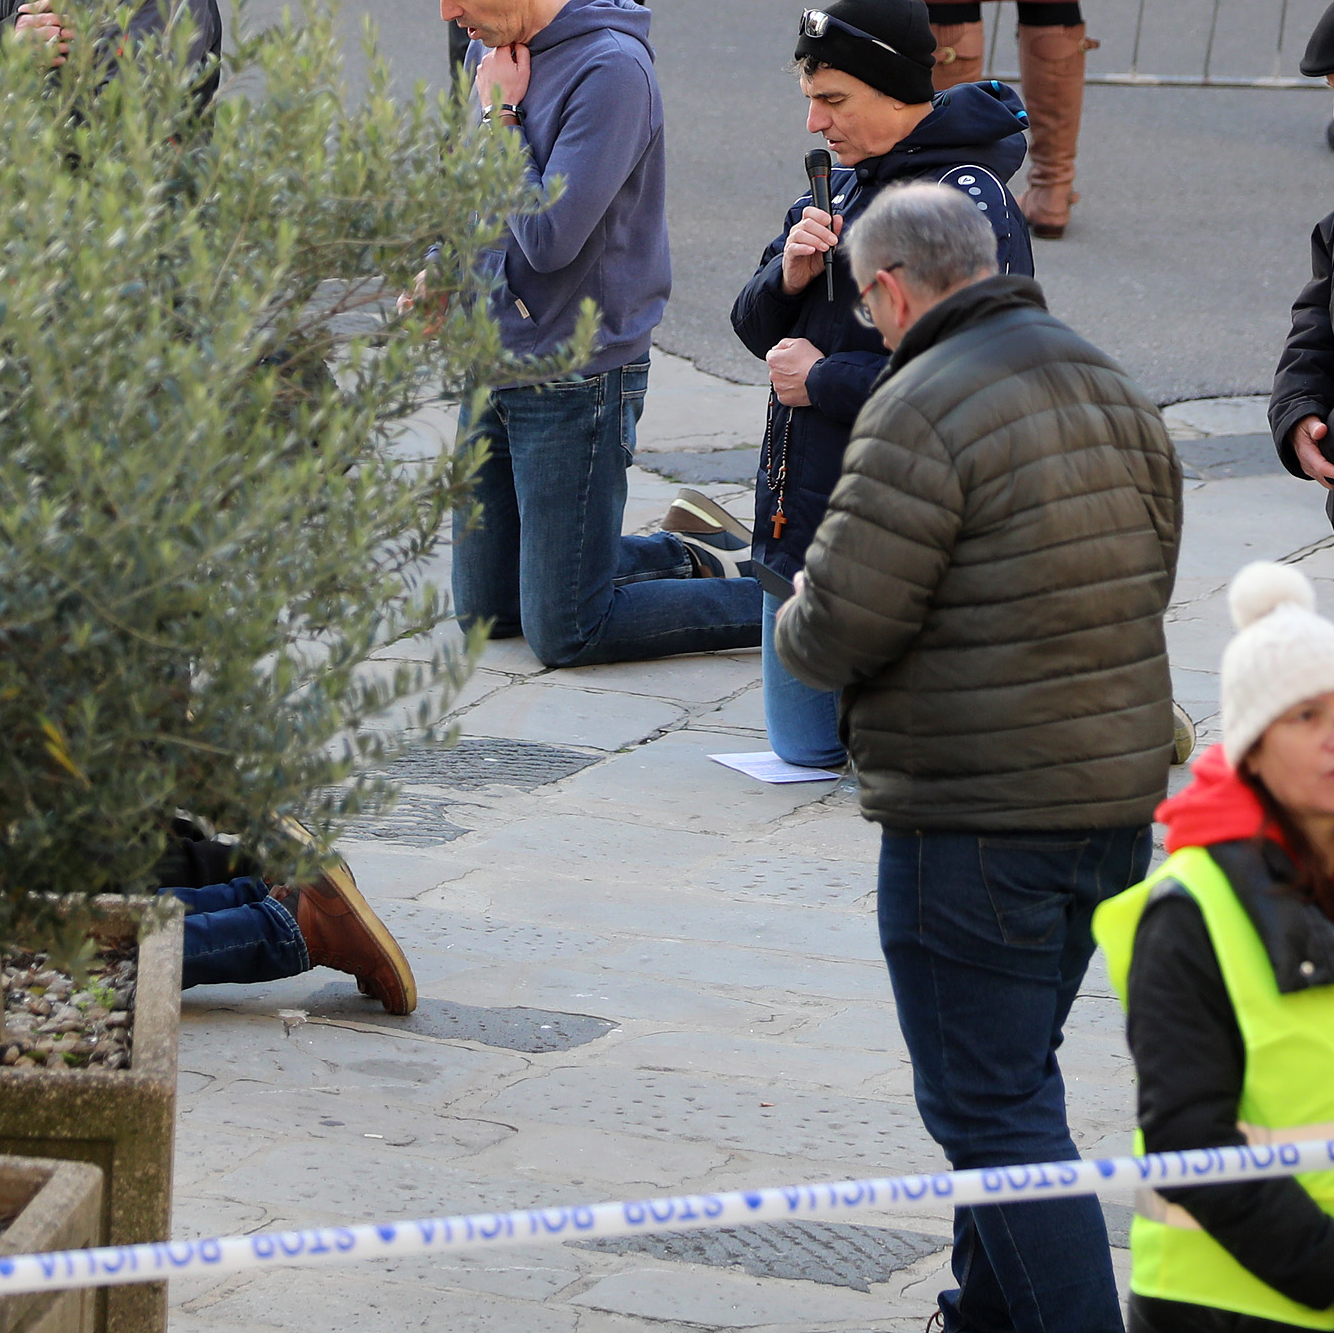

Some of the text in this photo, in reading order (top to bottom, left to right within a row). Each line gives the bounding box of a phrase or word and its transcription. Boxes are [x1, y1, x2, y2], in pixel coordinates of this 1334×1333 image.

[983, 1161, 1077, 1190] STOP
[624, 1196, 723, 1224] STOP
[253, 1228, 355, 1258] STOP
